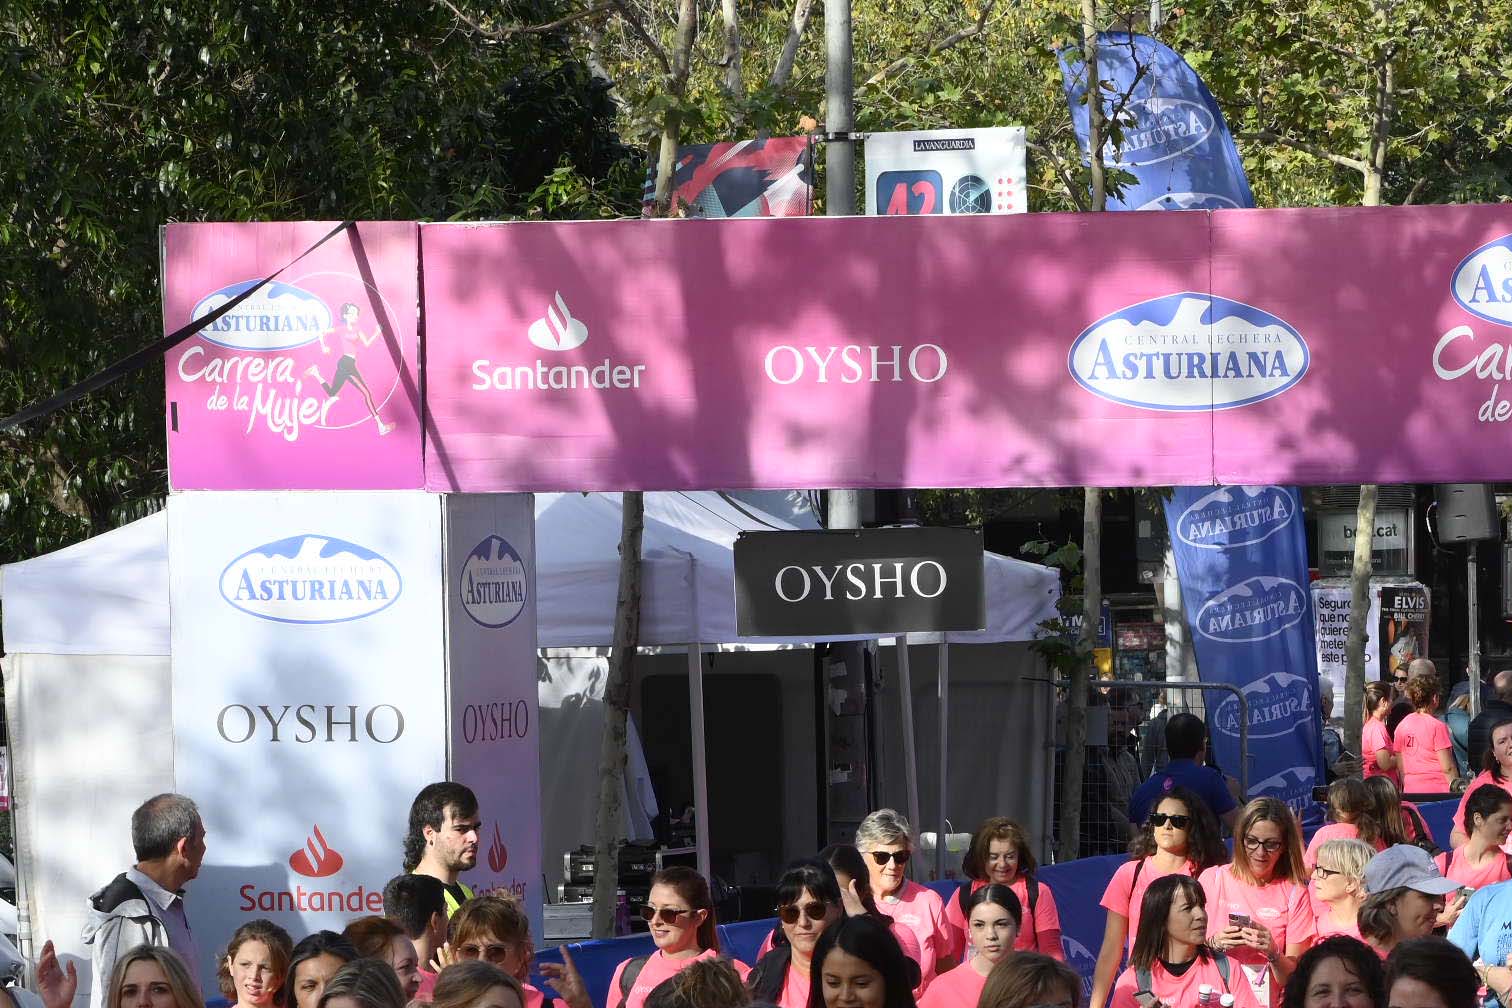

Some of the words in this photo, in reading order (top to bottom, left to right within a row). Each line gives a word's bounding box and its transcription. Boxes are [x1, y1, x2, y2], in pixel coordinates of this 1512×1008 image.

[1124, 334, 1199, 346] CENTRAL
[1208, 333, 1282, 345] LECHERA
[178, 346, 294, 383] Carrera
[472, 359, 645, 392] Santander
[764, 343, 948, 384] OYSHO
[1087, 337, 1290, 381] ASTURIANA
[207, 385, 228, 411] de
[233, 386, 248, 411] la
[246, 381, 339, 442] Mujer
[1478, 385, 1511, 422] de
[233, 567, 389, 602] ASTURIANA
[465, 569, 524, 605] ASTURIANA
[775, 560, 948, 602] OYSHO
[1319, 613, 1336, 624] que
[1394, 596, 1425, 609] ELVIS
[1321, 652, 1340, 664] este
[1341, 652, 1372, 665] po
[217, 703, 405, 744] OYSHO
[463, 698, 529, 744] OYSHO
[239, 884, 385, 913] Santande
